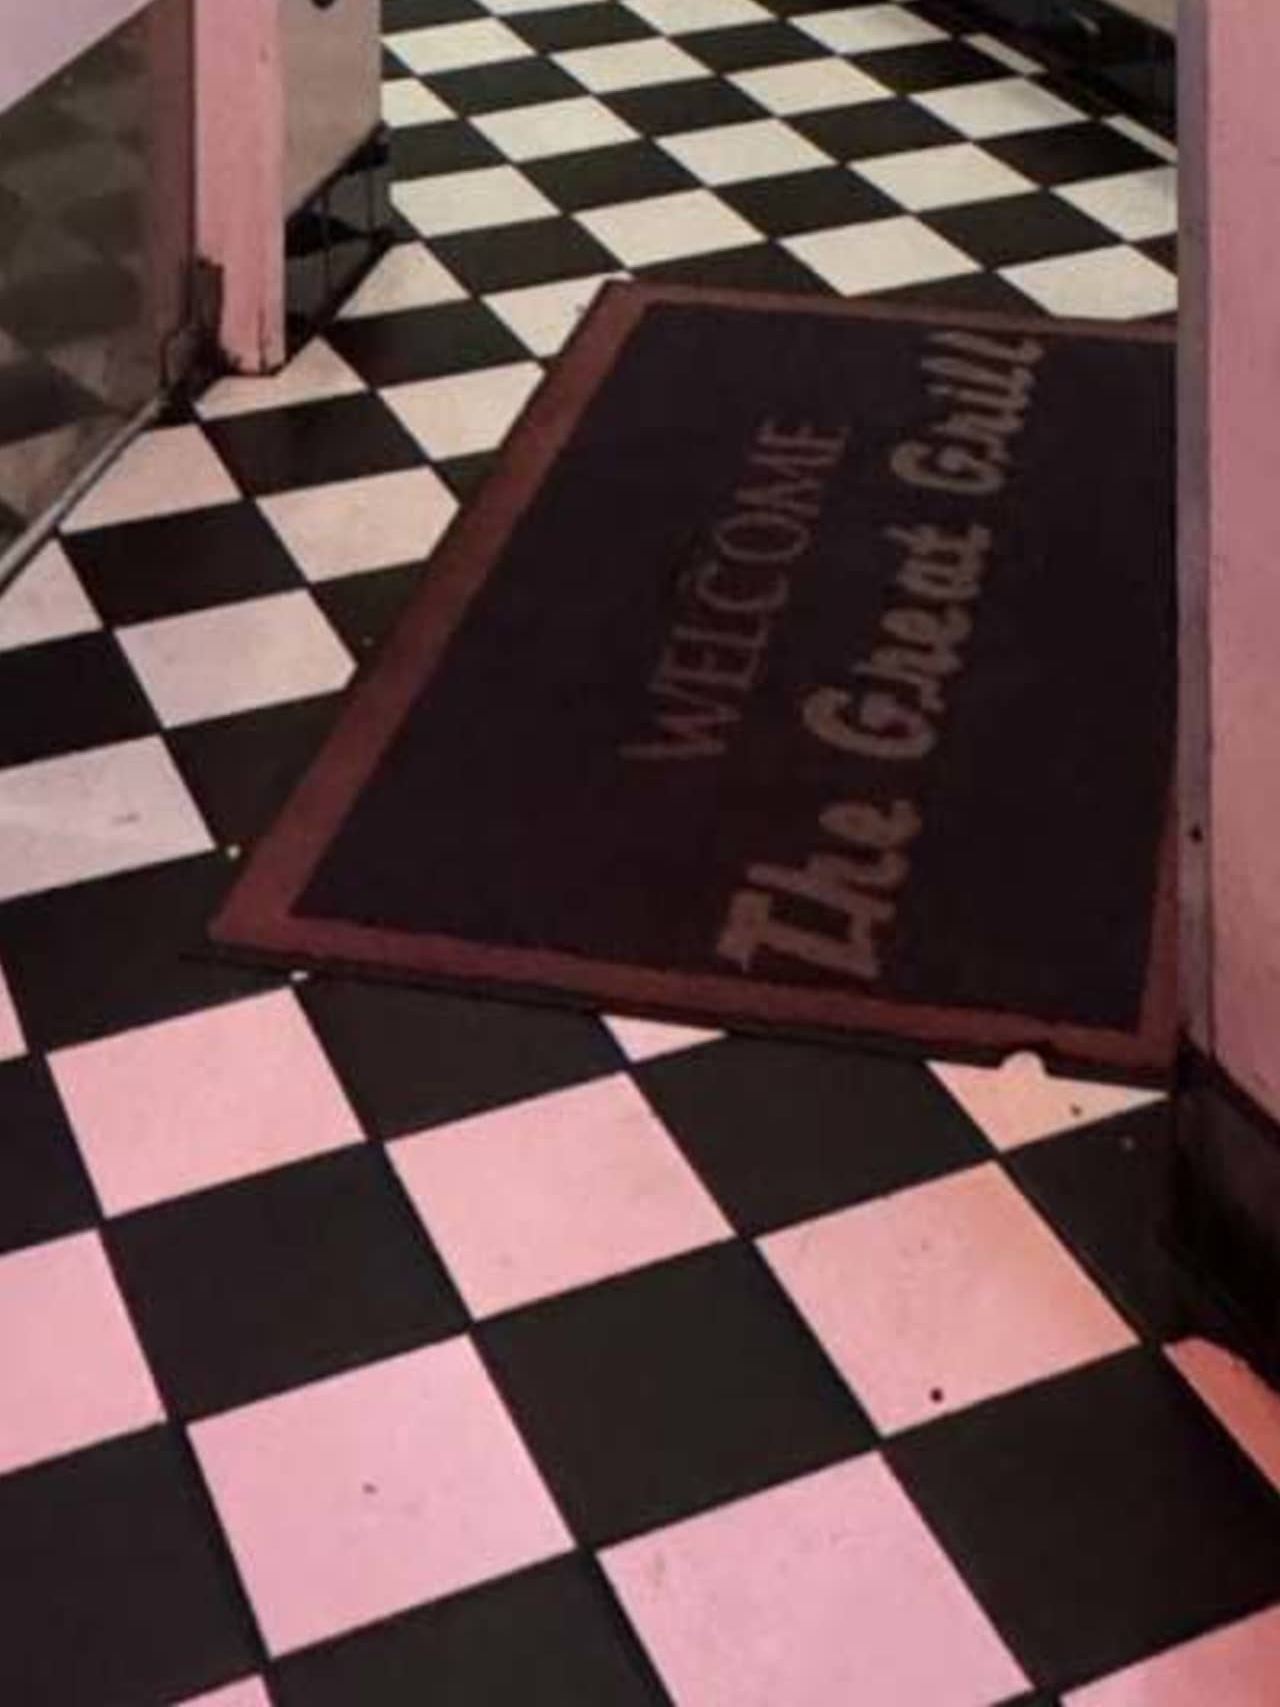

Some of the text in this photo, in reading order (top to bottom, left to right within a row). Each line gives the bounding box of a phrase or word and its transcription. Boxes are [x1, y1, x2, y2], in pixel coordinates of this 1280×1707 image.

[622, 412, 850, 764] WELCOME
[717, 330, 1045, 980] The Great Grill
